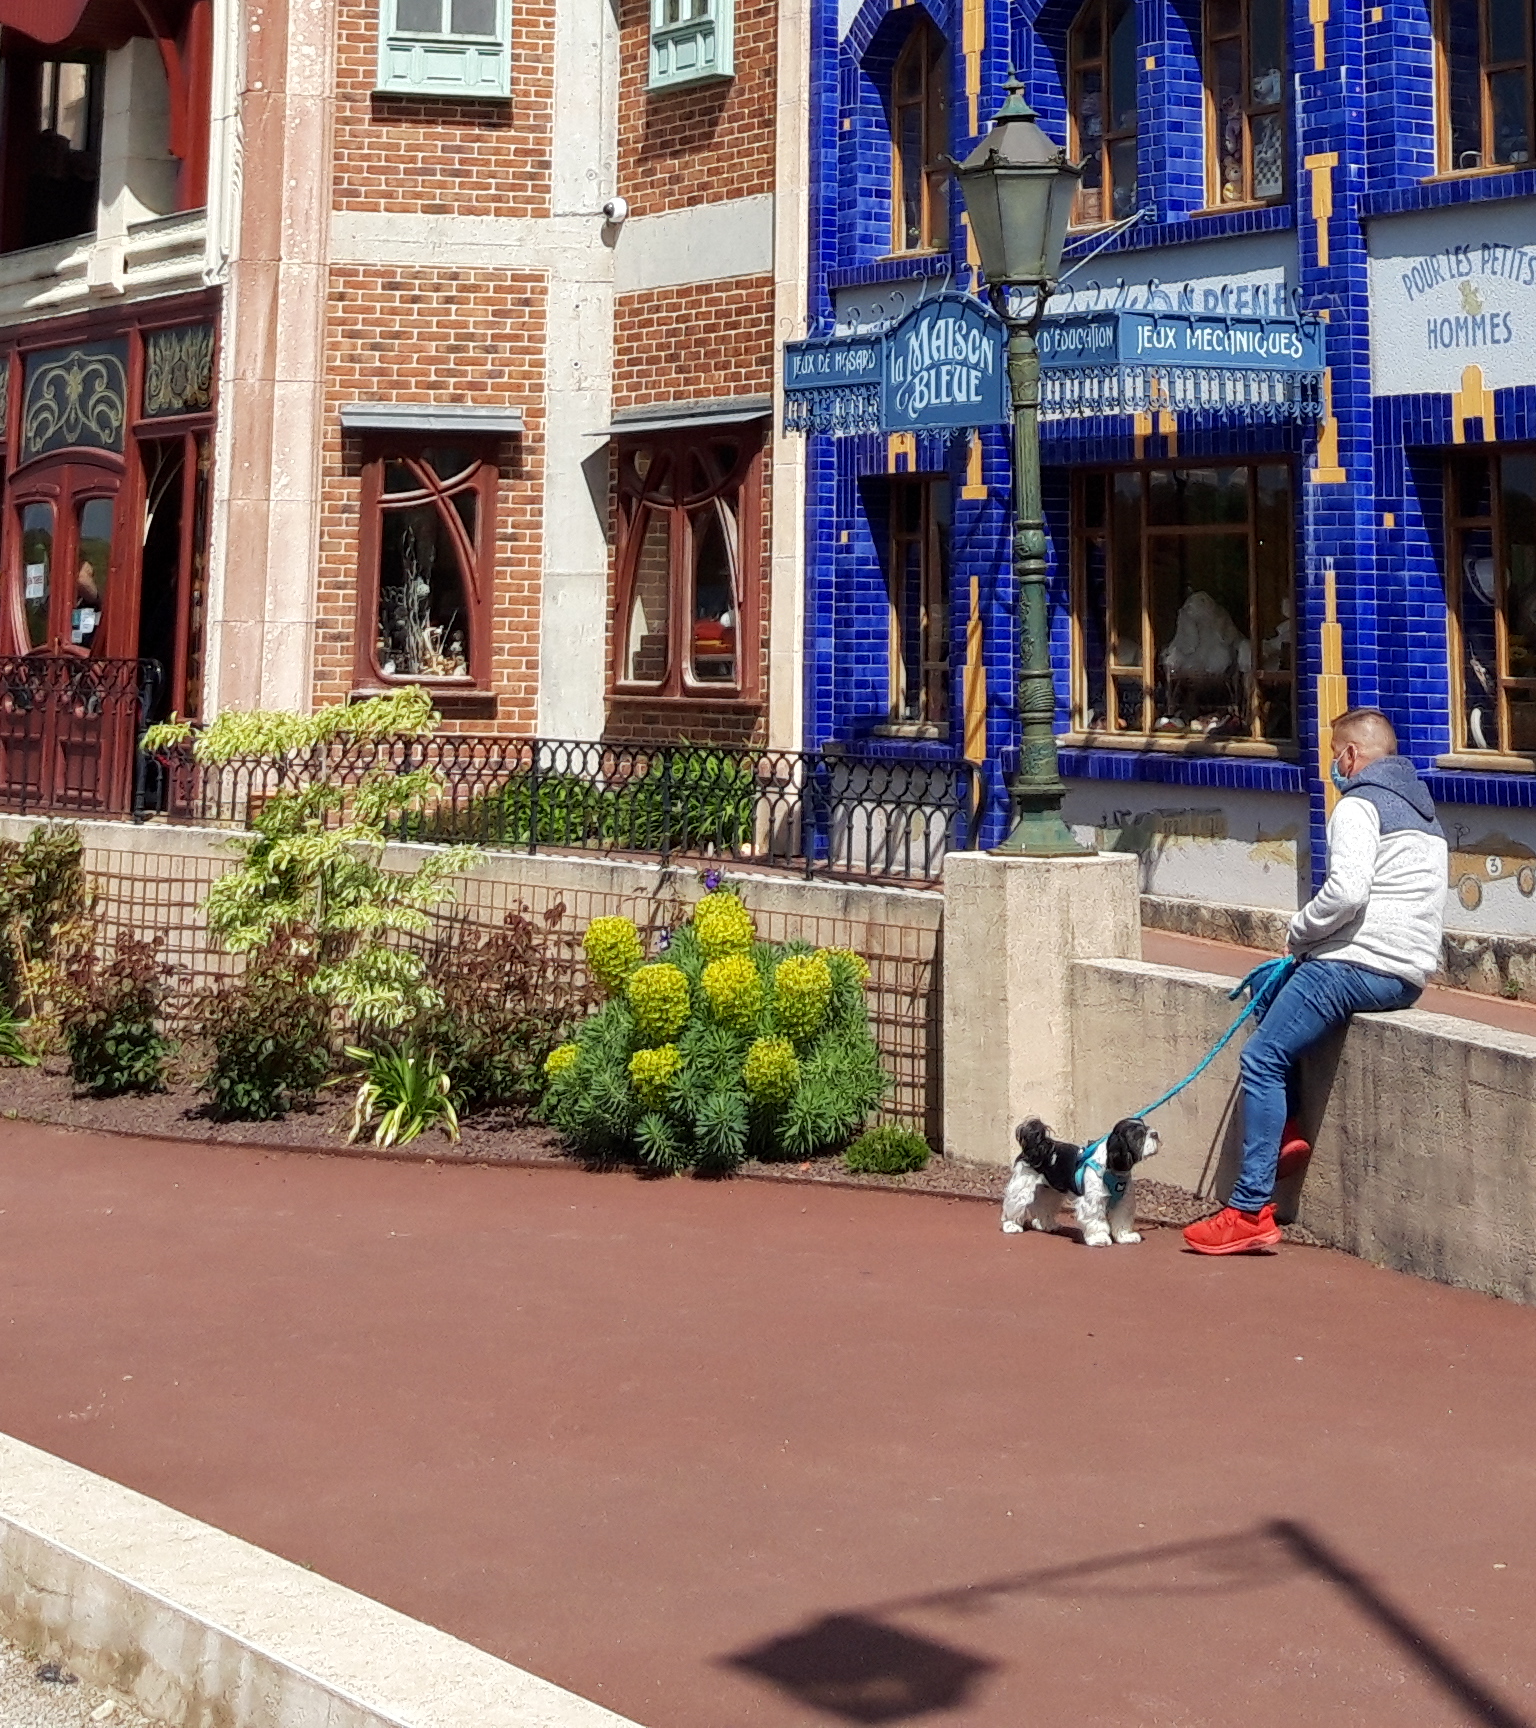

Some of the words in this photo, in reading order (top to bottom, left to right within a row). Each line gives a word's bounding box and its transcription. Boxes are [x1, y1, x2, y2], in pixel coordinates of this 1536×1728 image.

[1402, 254, 1446, 301] POUR
[1445, 244, 1473, 279] LES
[1136, 325, 1177, 354] JEUX
[1427, 311, 1513, 350] HOMMES
[792, 354, 815, 379] JEUX
[818, 353, 831, 373] DE
[835, 349, 876, 376] HASARD
[896, 316, 995, 410] MAISON
[908, 364, 983, 418] BLEUE
[1489, 857, 1499, 874] 3
